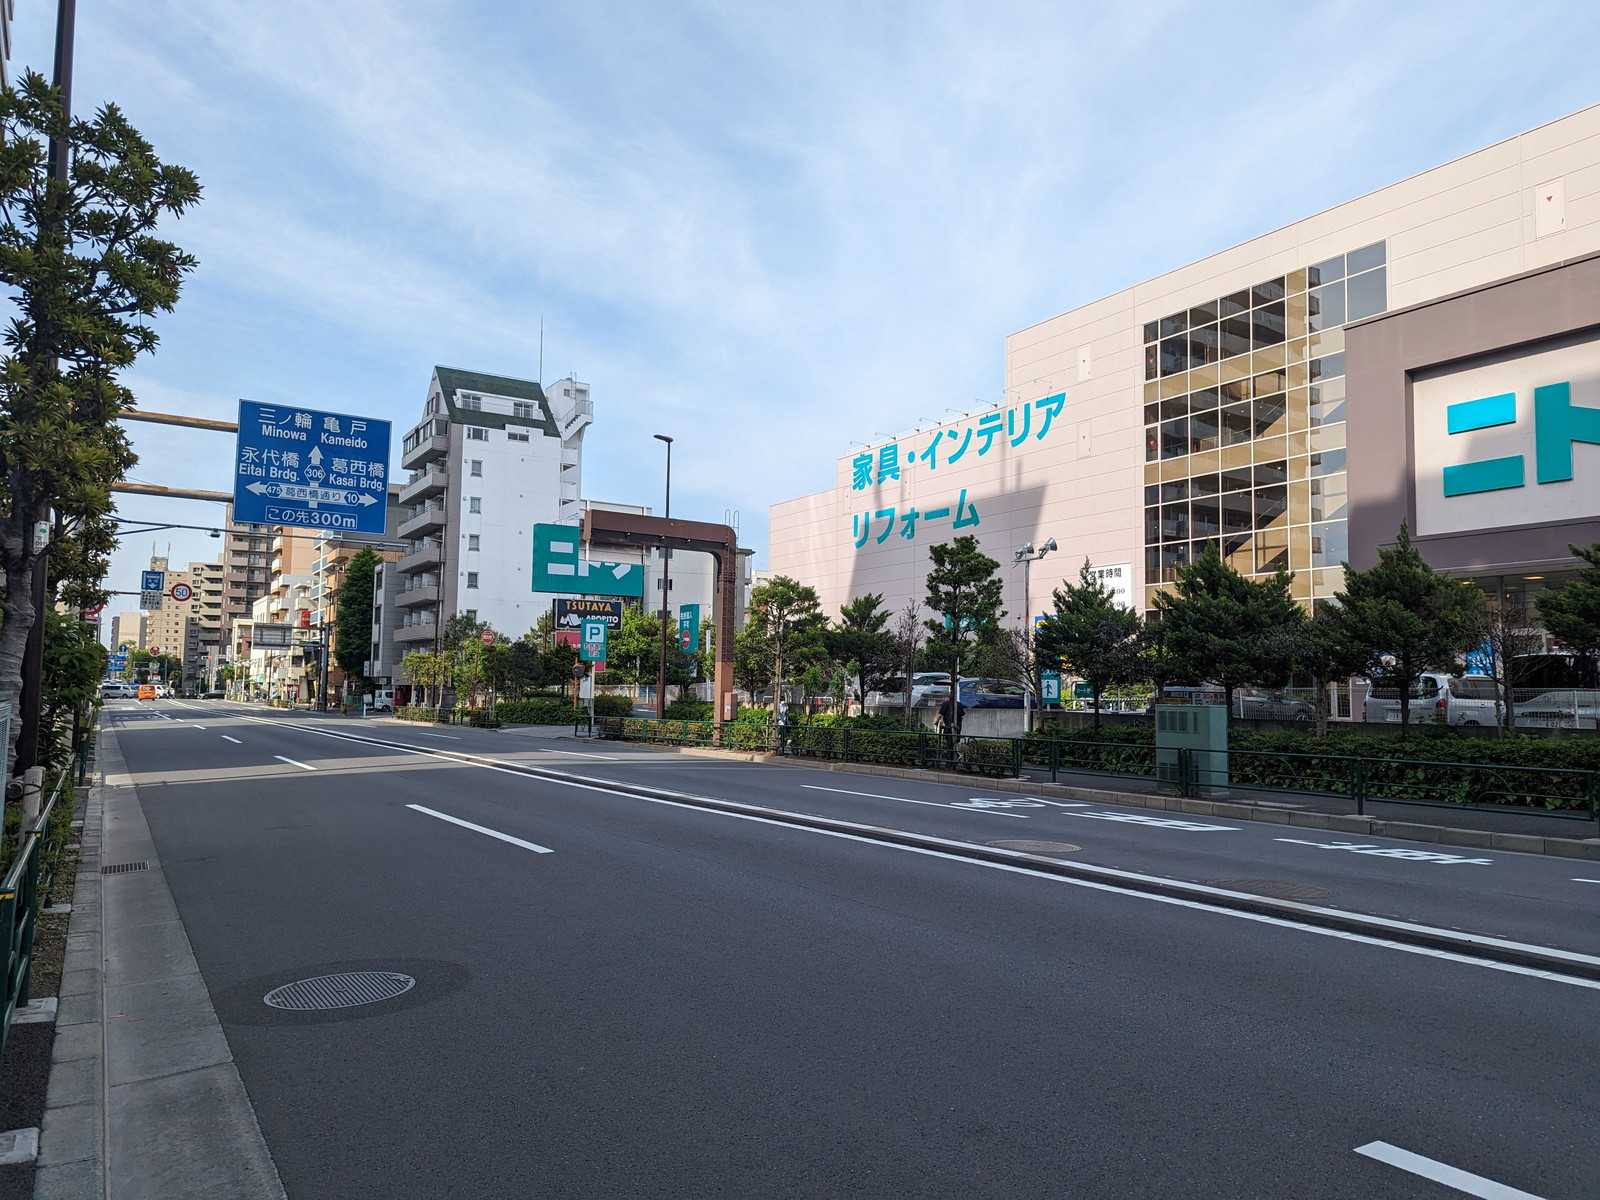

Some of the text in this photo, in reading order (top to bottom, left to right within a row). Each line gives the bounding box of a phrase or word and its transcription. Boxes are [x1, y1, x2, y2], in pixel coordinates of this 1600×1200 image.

[258, 407, 313, 430] 三ノ輪
[323, 416, 367, 435] 亀戸
[262, 424, 307, 441] Minowa
[321, 432, 368, 449] Kameido
[852, 392, 1067, 491] 家具・インテリア
[241, 446, 300, 469] 永代橋
[239, 462, 300, 482] Eitai Brdg.
[307, 469, 323, 479] 306
[331, 457, 385, 479] 葛西橋
[267, 485, 282, 494] 475
[329, 473, 385, 492] Kasai Brdg.
[285, 486, 342, 502] 葛西橋通り
[346, 493, 358, 503] 10
[268, 508, 356, 528] この先300m
[853, 488, 981, 550] リフォーム
[175, 587, 188, 597] 50
[565, 600, 612, 612] TSUTAYA
